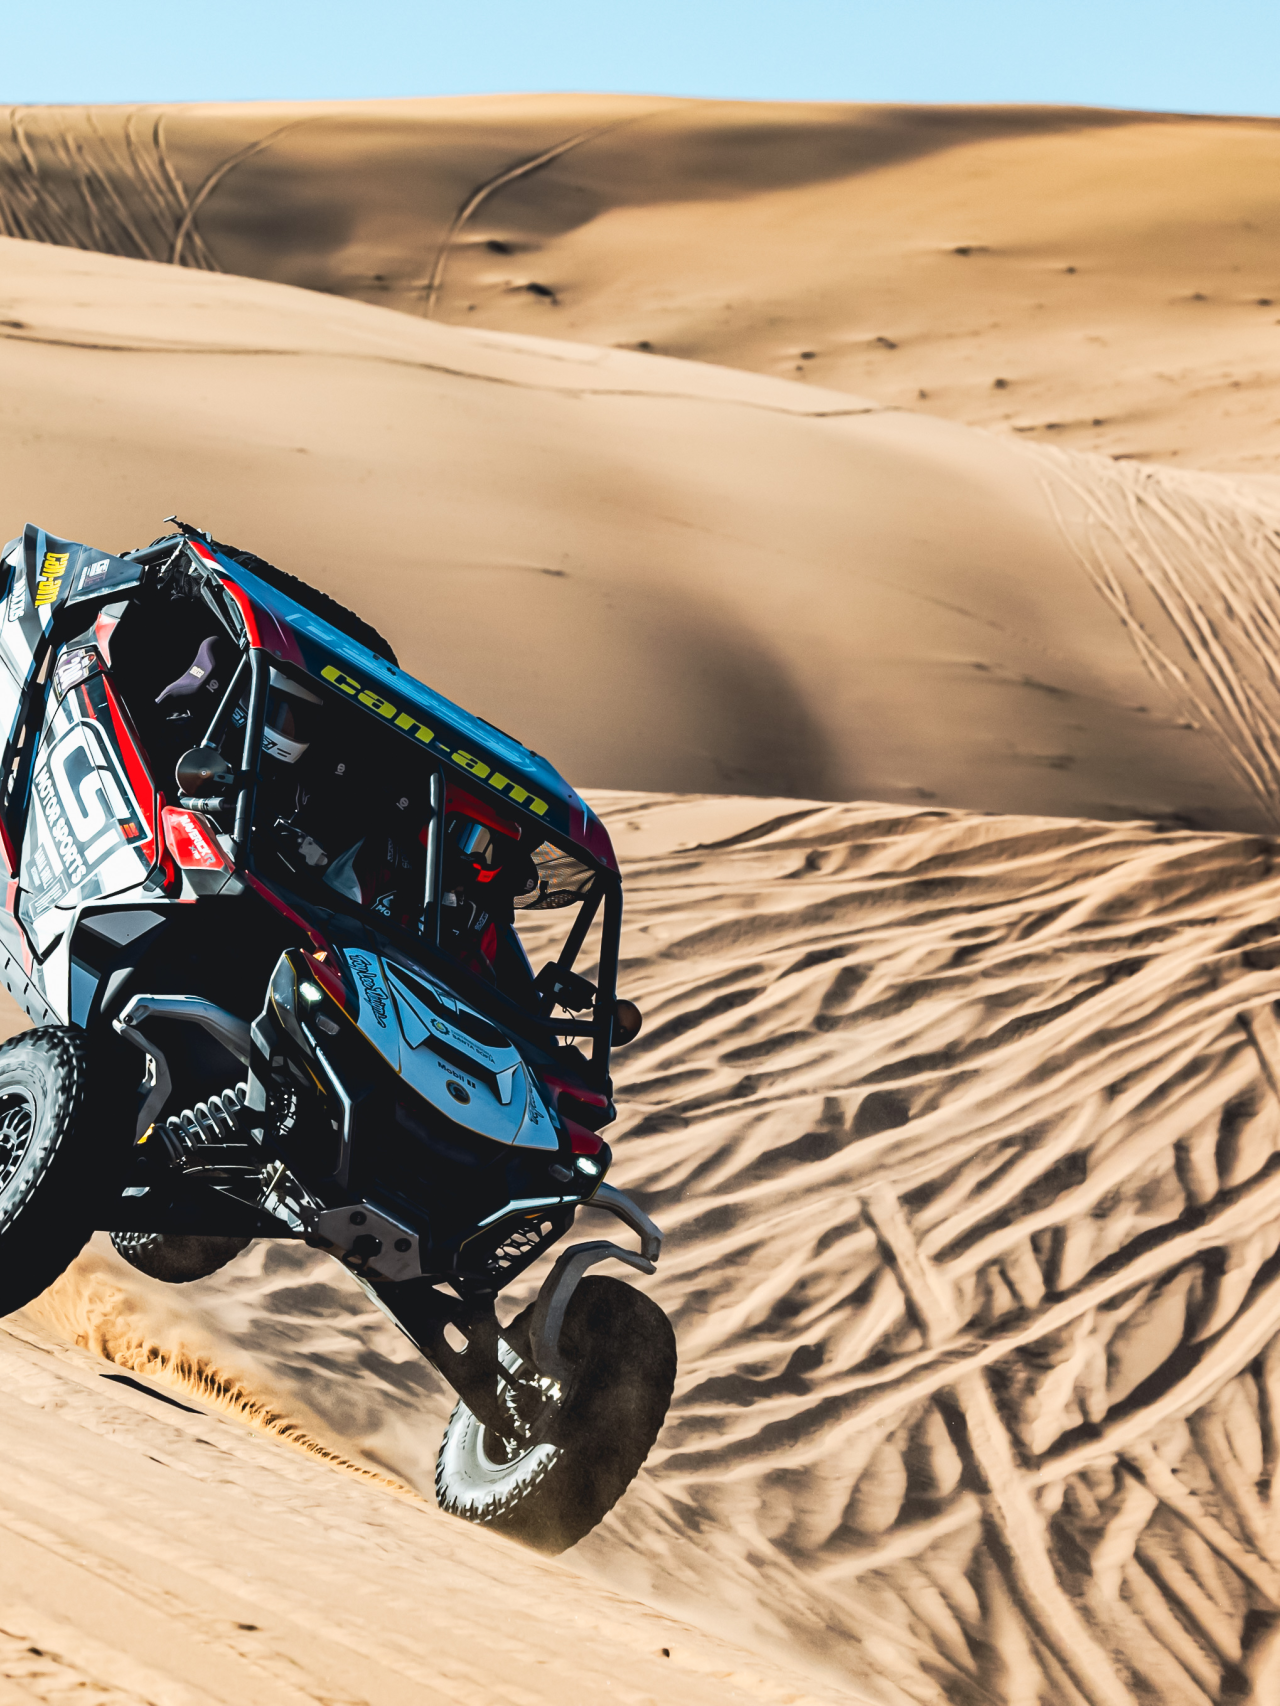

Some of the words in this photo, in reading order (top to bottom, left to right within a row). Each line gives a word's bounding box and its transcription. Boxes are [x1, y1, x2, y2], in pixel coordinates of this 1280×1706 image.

[321, 664, 549, 816] can-am
[35, 765, 62, 828] MOTOR
[52, 817, 87, 885] SPORTS
[179, 814, 211, 857] MAVERICK
